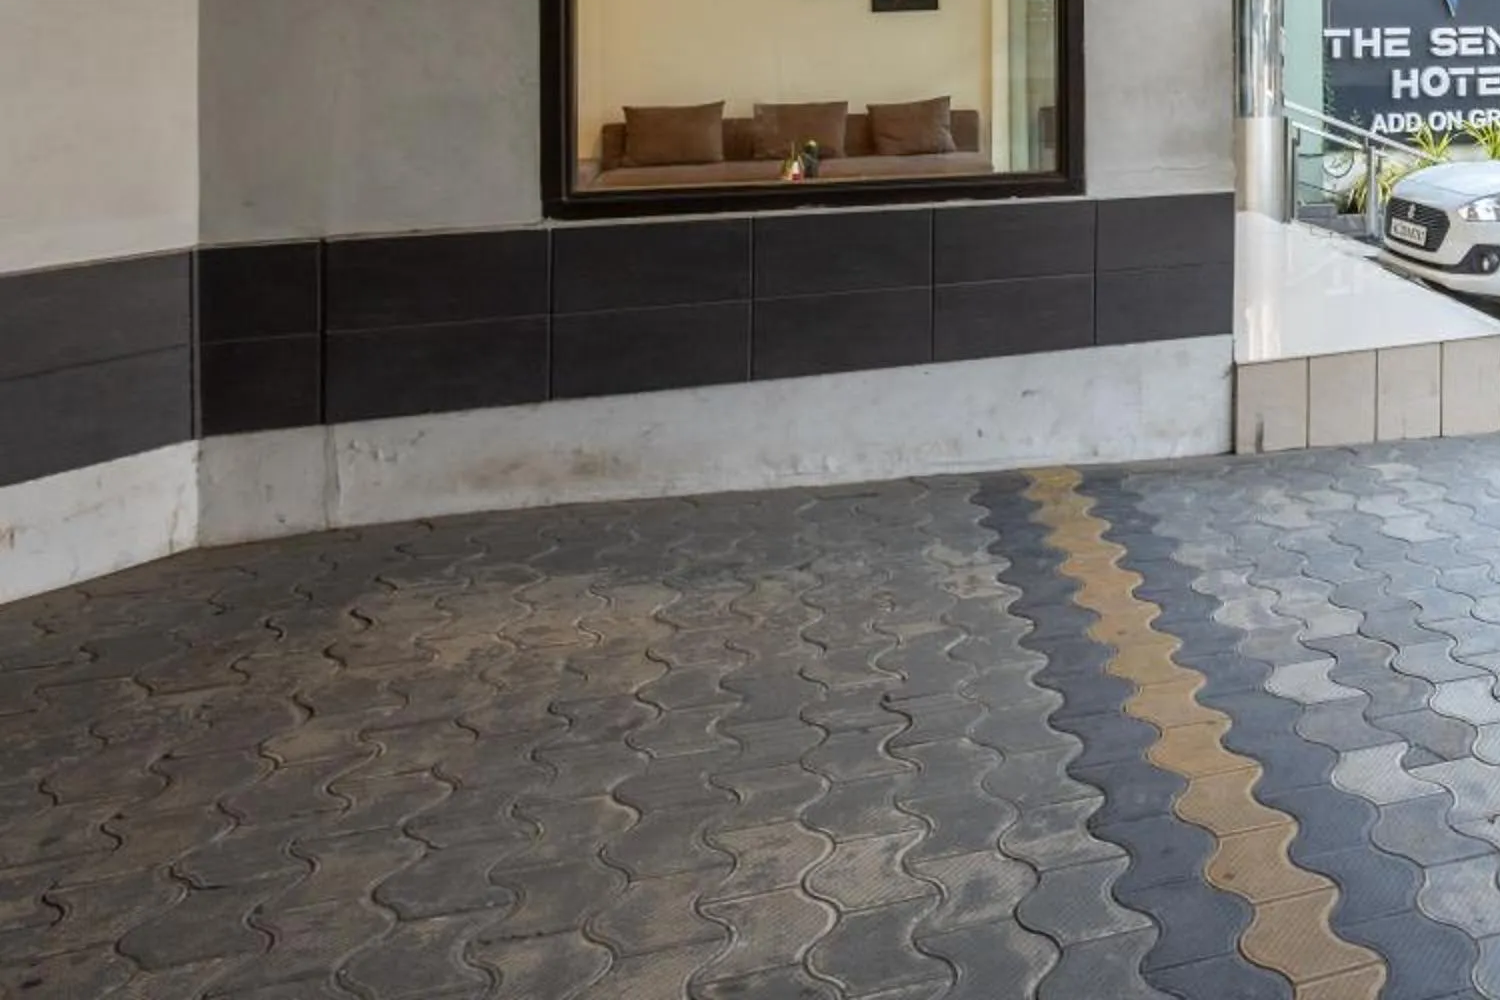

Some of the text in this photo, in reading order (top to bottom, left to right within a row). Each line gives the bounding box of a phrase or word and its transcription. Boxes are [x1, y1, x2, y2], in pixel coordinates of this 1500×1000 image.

[1324, 27, 1411, 59] THE
[1371, 112, 1422, 134] ADD
[1428, 109, 1463, 133] ON
